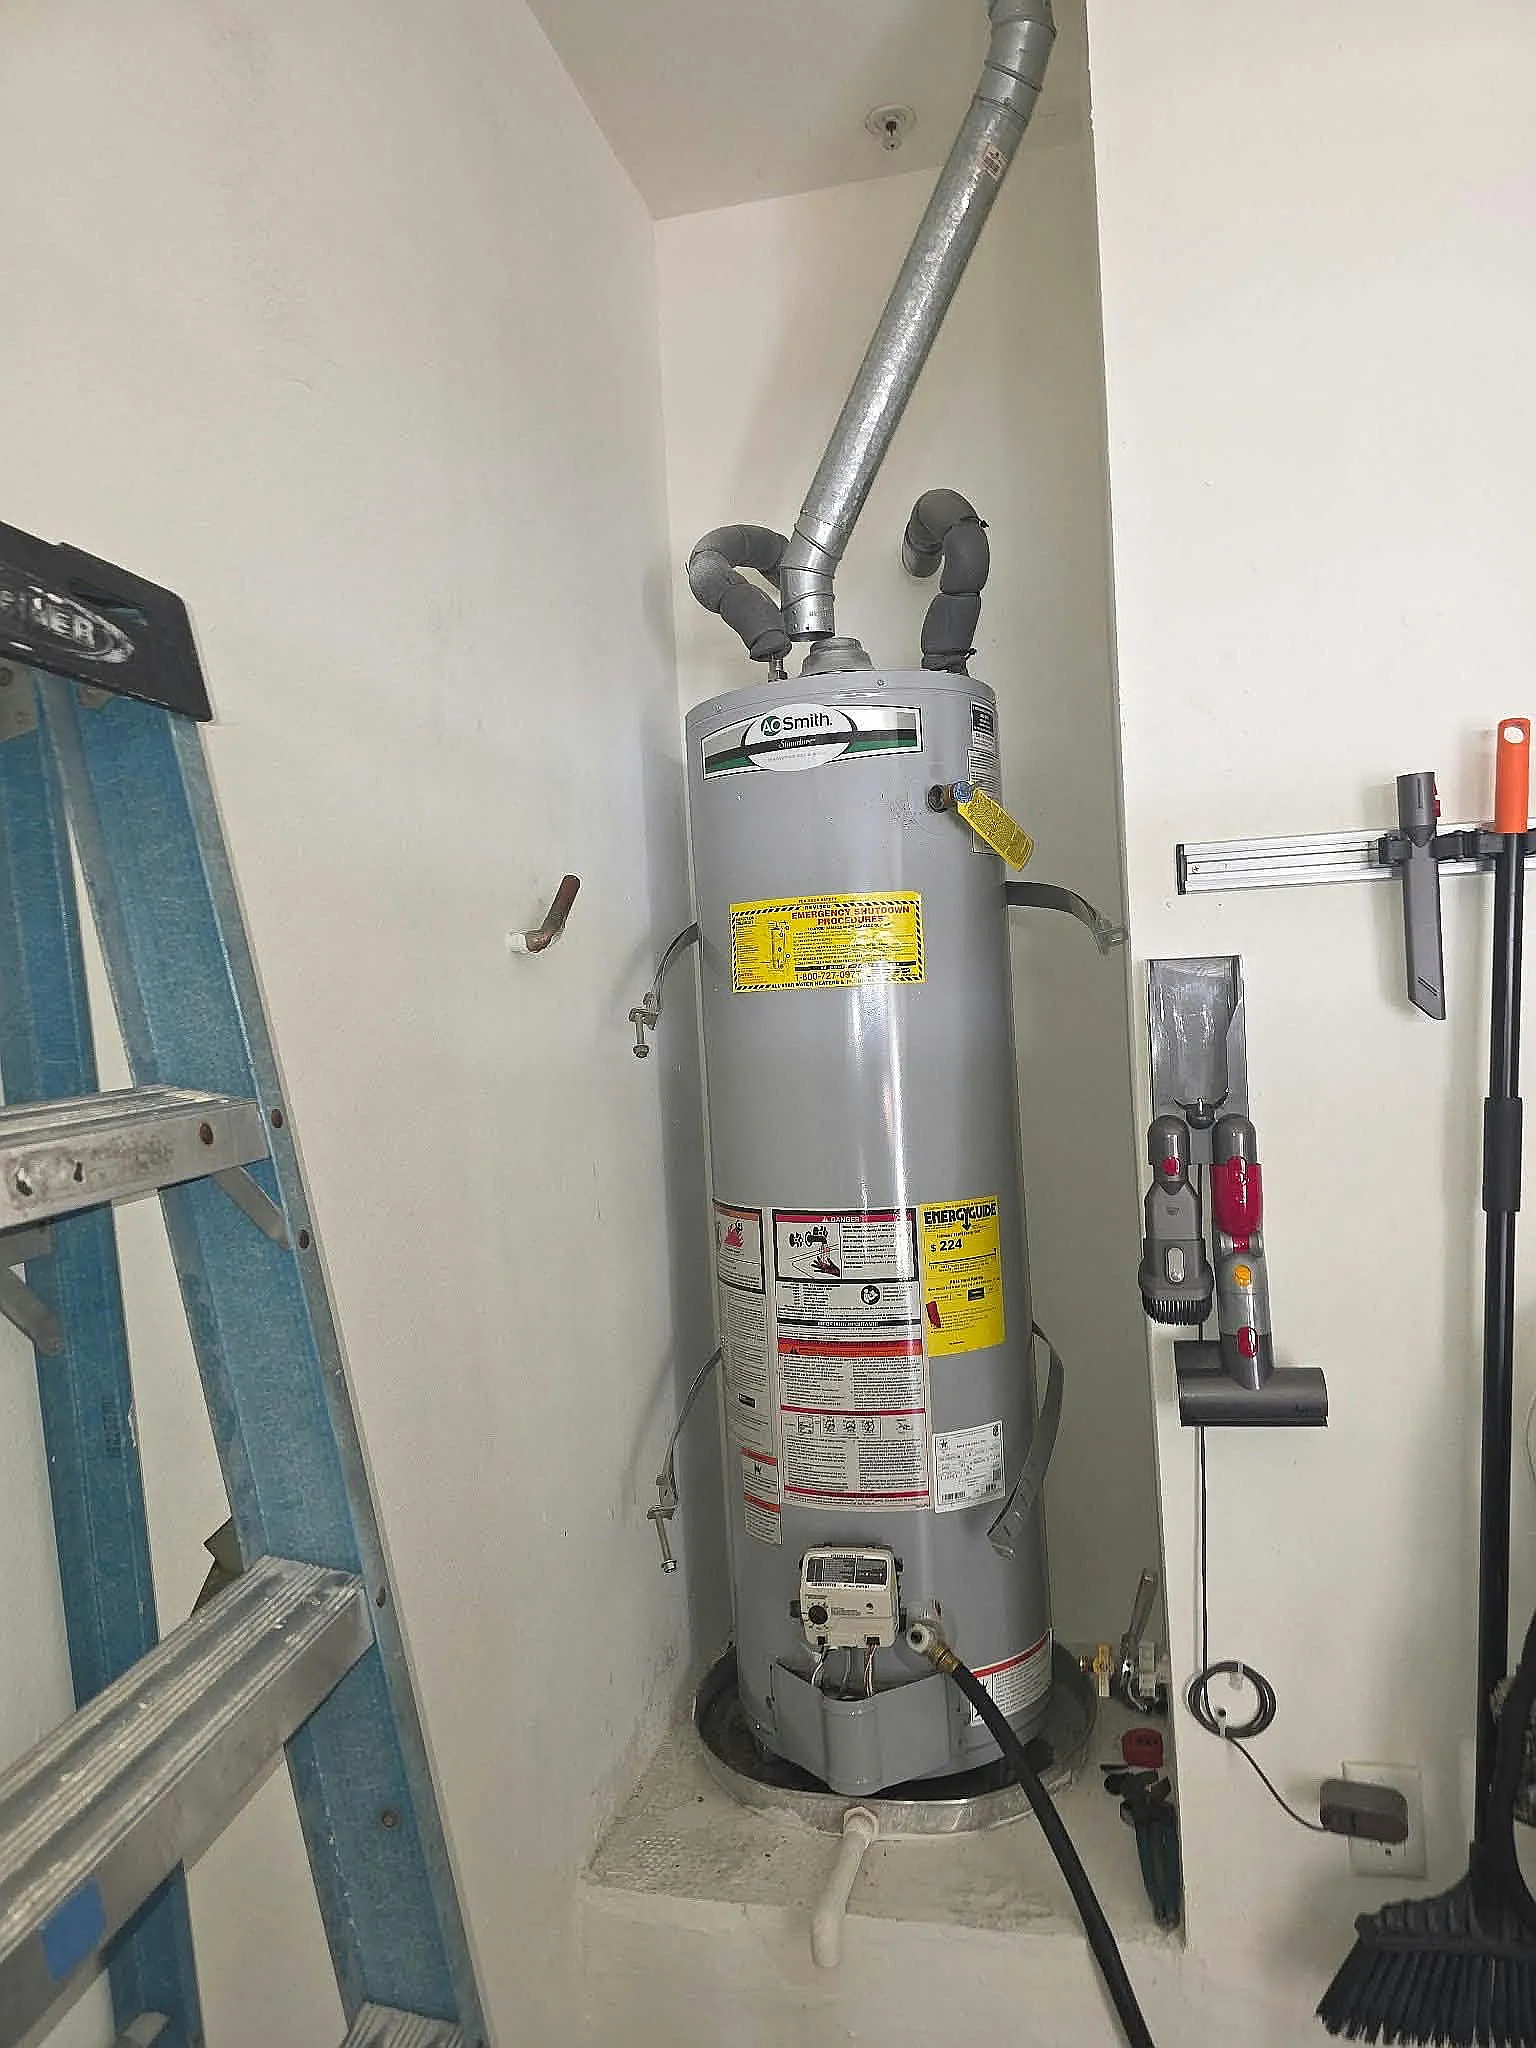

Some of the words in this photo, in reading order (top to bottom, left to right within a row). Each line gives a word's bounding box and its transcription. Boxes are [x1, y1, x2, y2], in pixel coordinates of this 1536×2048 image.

[792, 908, 851, 920] EMERGENCY
[853, 905, 910, 917] SHUTDOWN
[817, 915, 884, 926] PROCEDURES
[930, 1243, 937, 1253] $
[939, 1238, 963, 1252] 224
